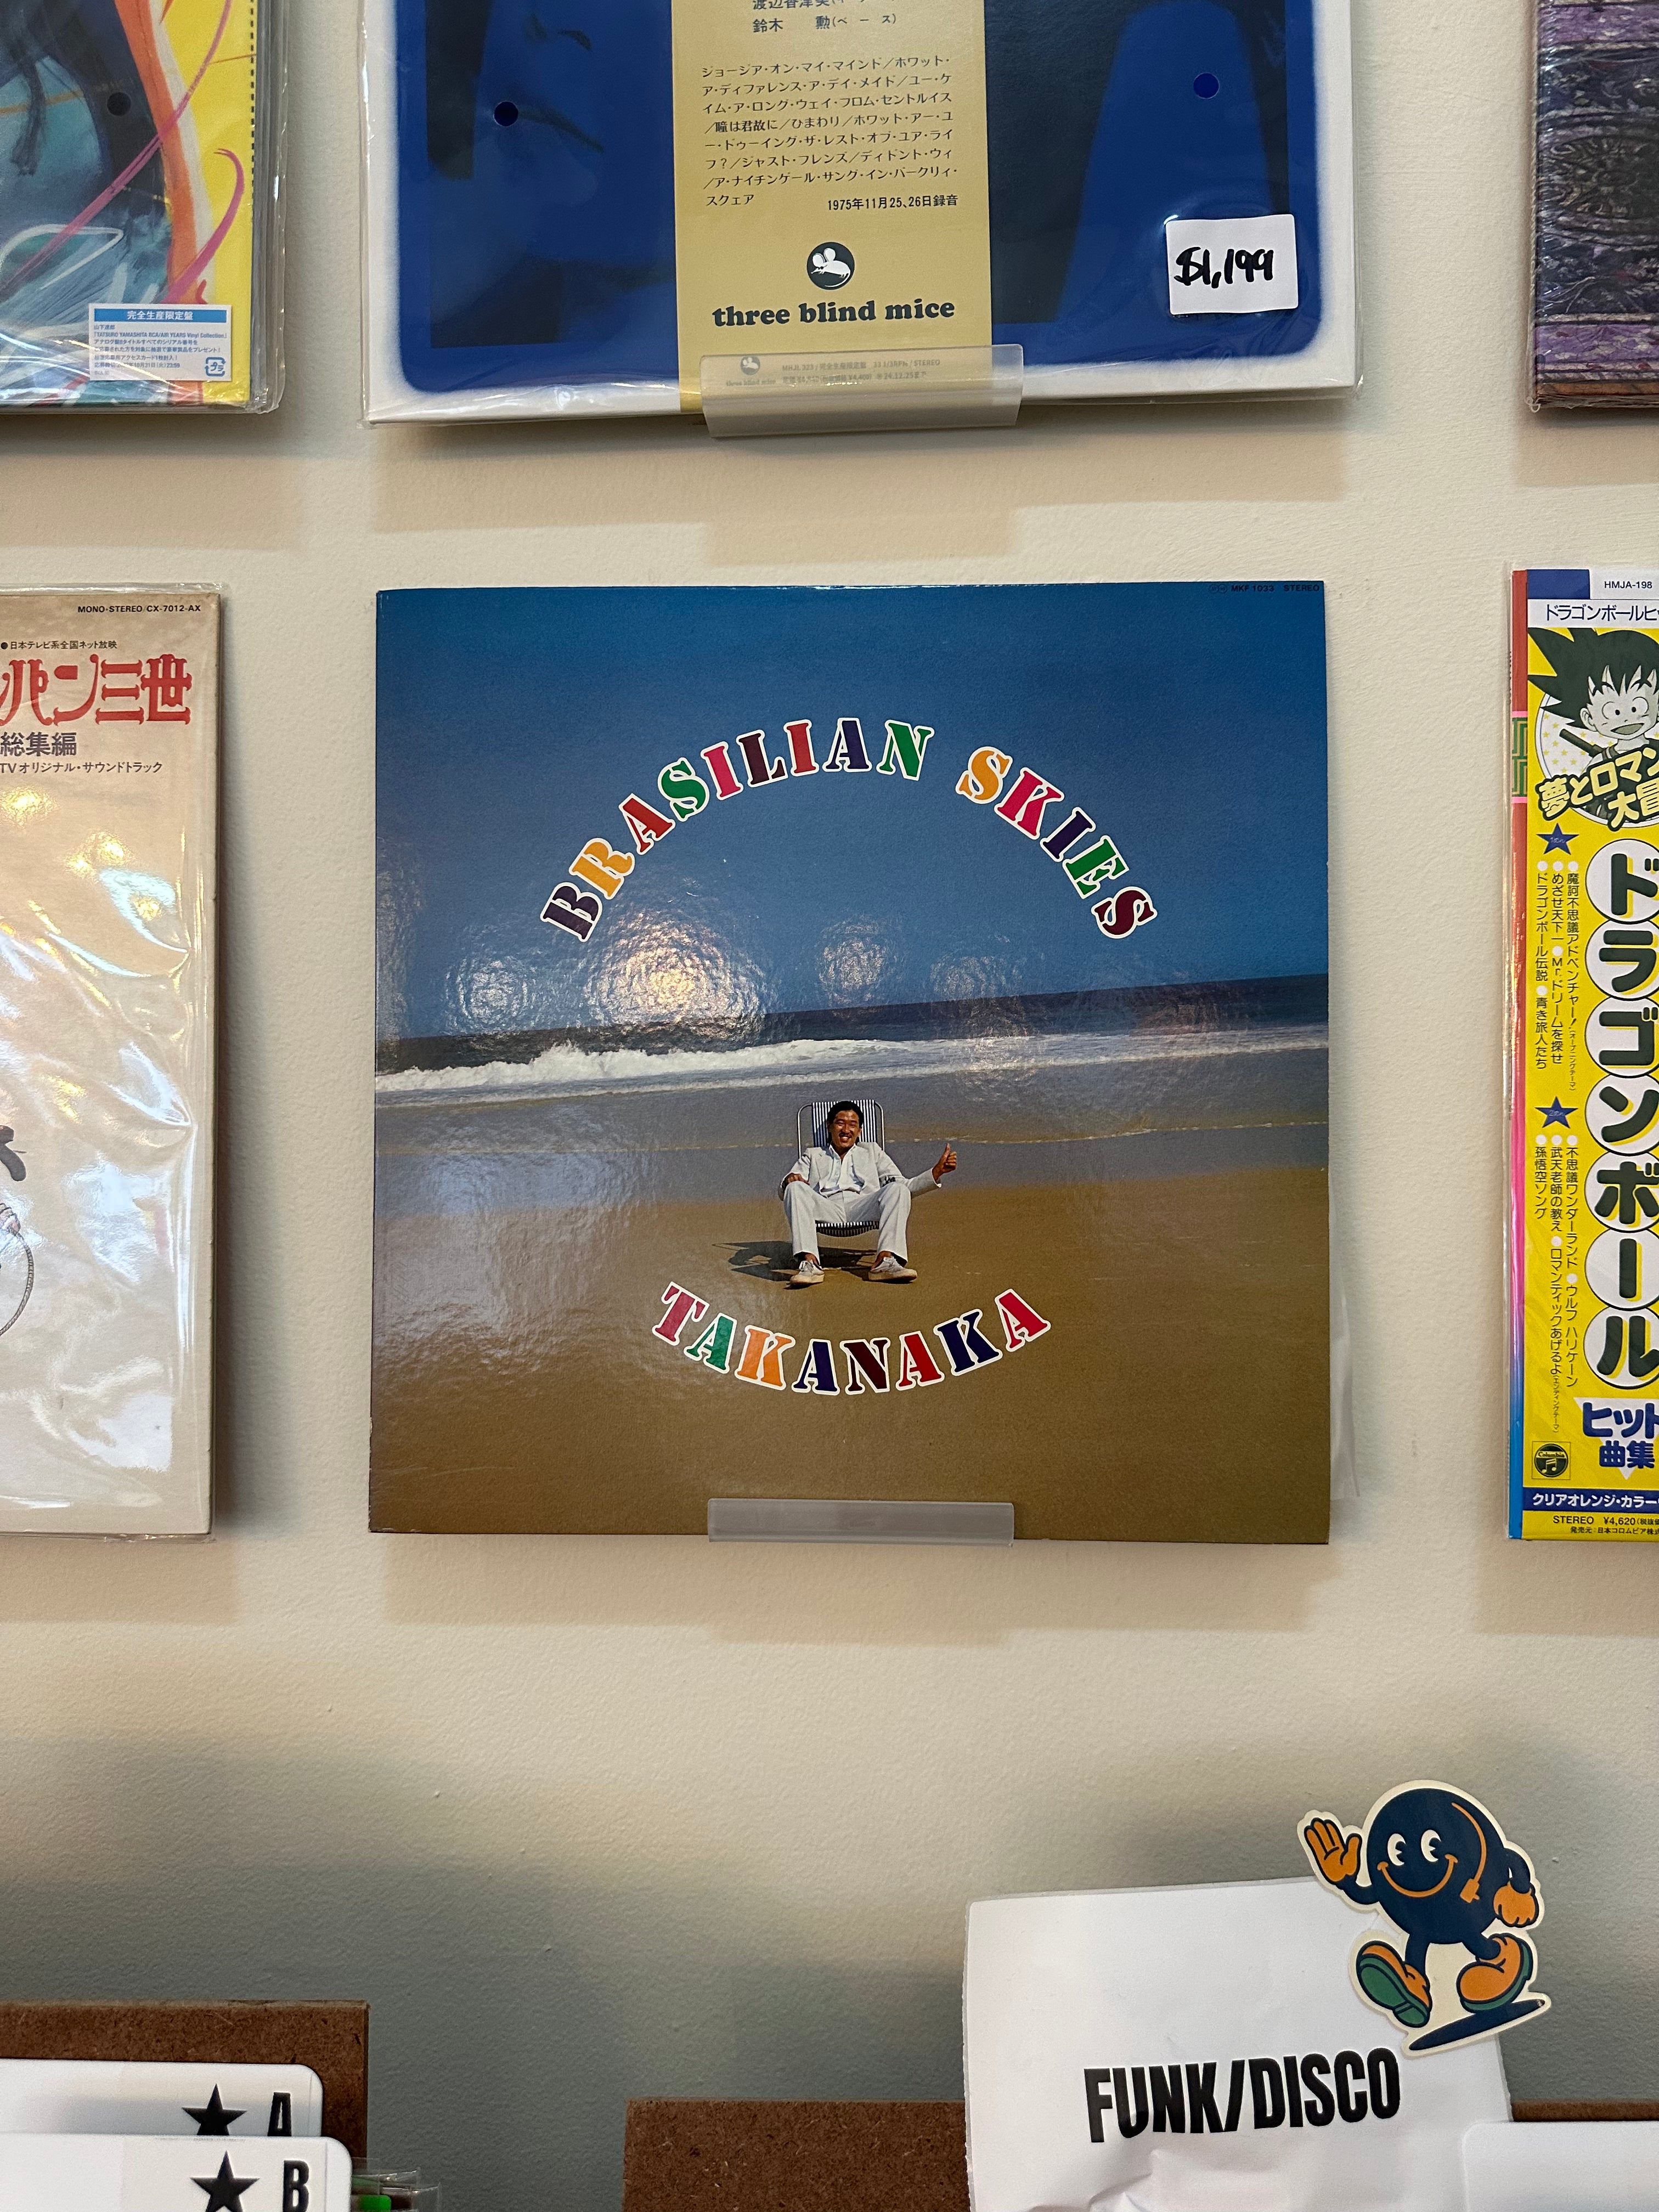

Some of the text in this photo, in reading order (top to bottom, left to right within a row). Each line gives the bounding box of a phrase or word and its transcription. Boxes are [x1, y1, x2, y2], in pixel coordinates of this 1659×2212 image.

[753, 18, 783, 33] 鈴木
[1173, 246, 1274, 289] $1,199
[127, 311, 193, 320] 完全生産限定盤
[713, 298, 955, 327] three blind mice
[1604, 581, 1652, 589] HMJA-198
[540, 717, 1158, 942] BRASILIAN SKIES
[652, 1280, 1051, 1396] TAKANAKA
[1600, 1440, 1655, 1469] 曲集
[1532, 1493, 1659, 1508] クリアオレンジ・カラー
[1553, 1516, 1594, 1524] STEREO
[1084, 2047, 1401, 2143] FUNK/DISCO
[268, 2092, 292, 2136] A
[283, 2159, 309, 2212] B
